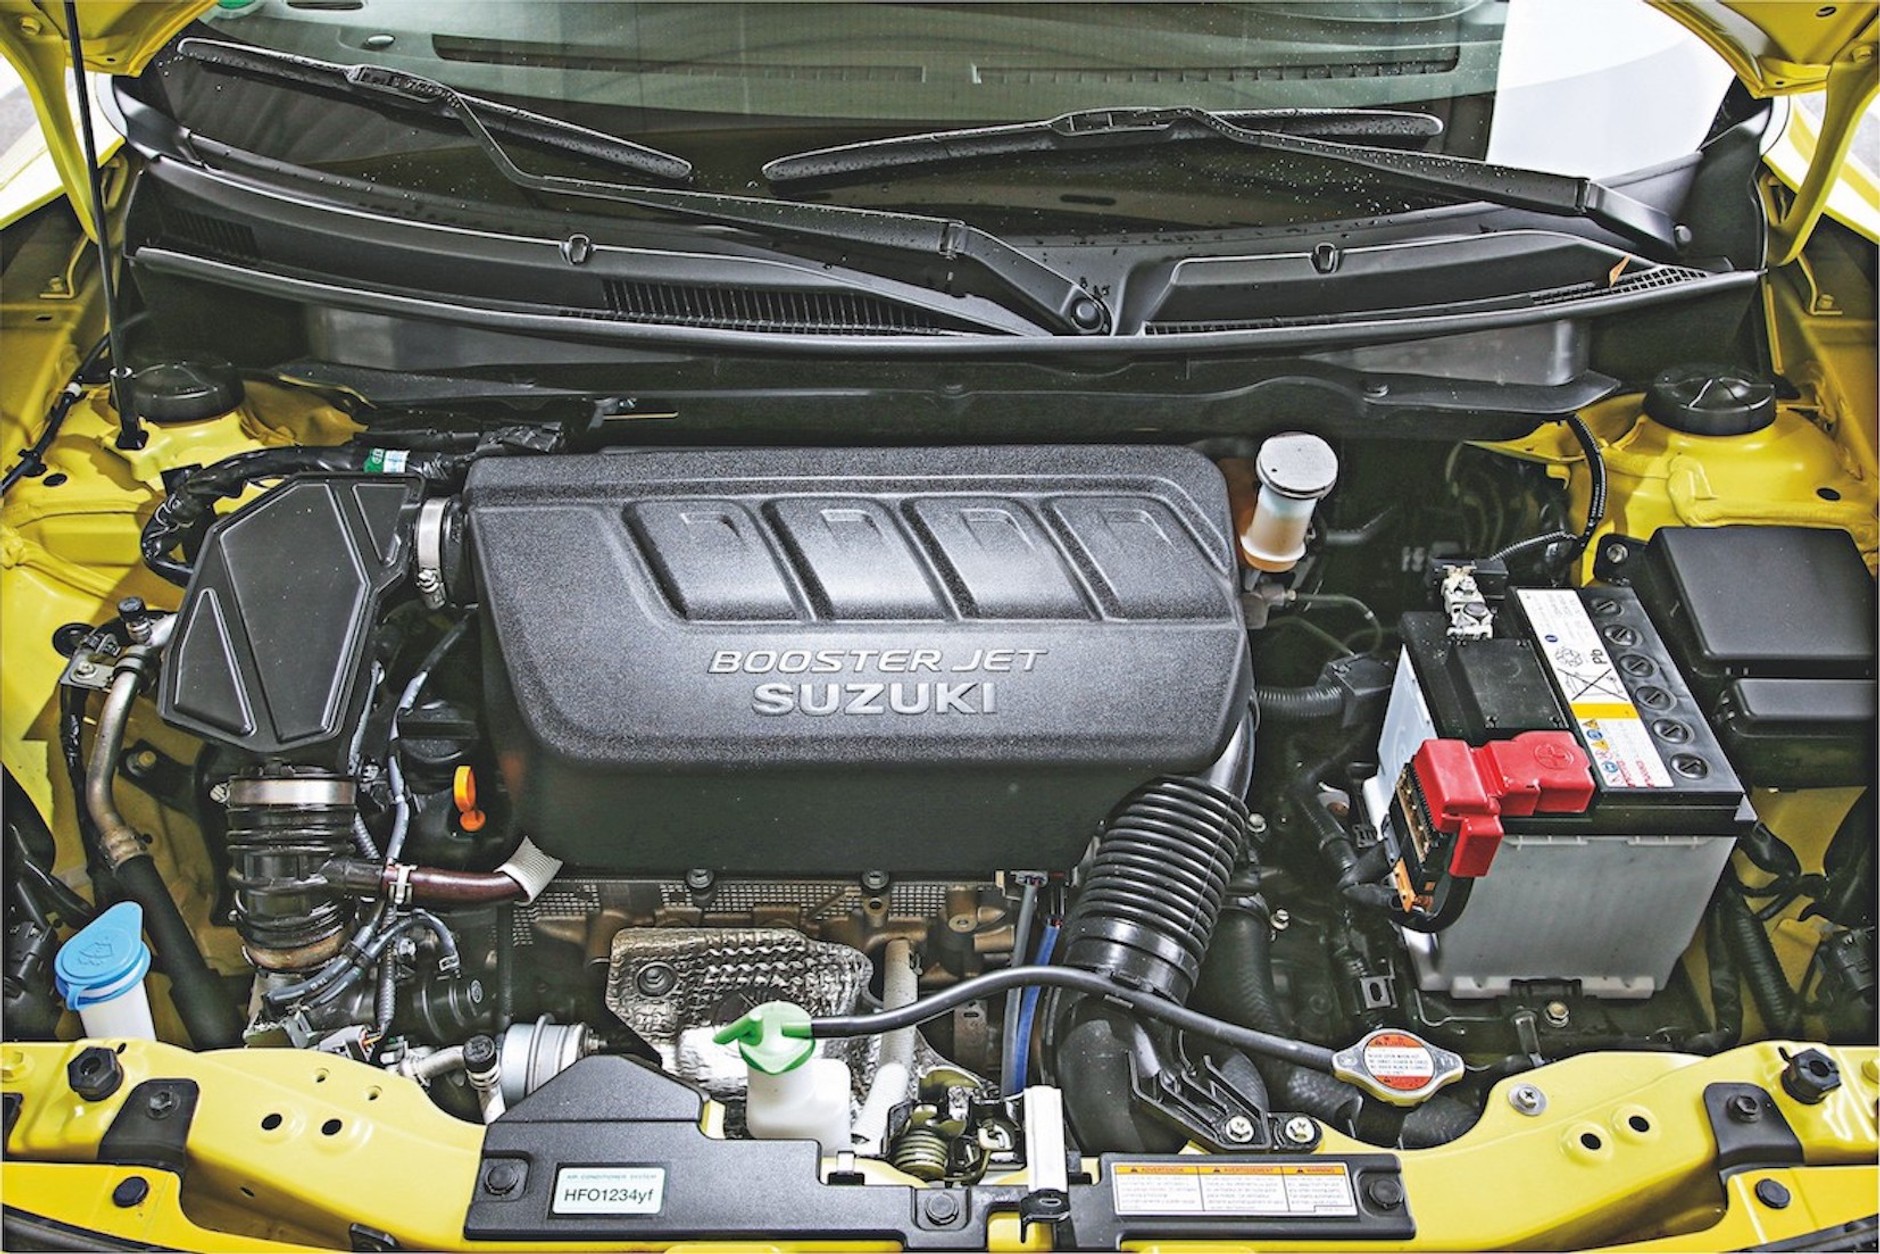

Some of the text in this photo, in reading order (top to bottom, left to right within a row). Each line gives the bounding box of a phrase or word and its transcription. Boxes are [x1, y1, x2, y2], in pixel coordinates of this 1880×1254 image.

[706, 649, 1049, 674] BOOSTER JET
[751, 682, 998, 716] SUZUKI
[564, 1187, 655, 1205] HFO1234yf
